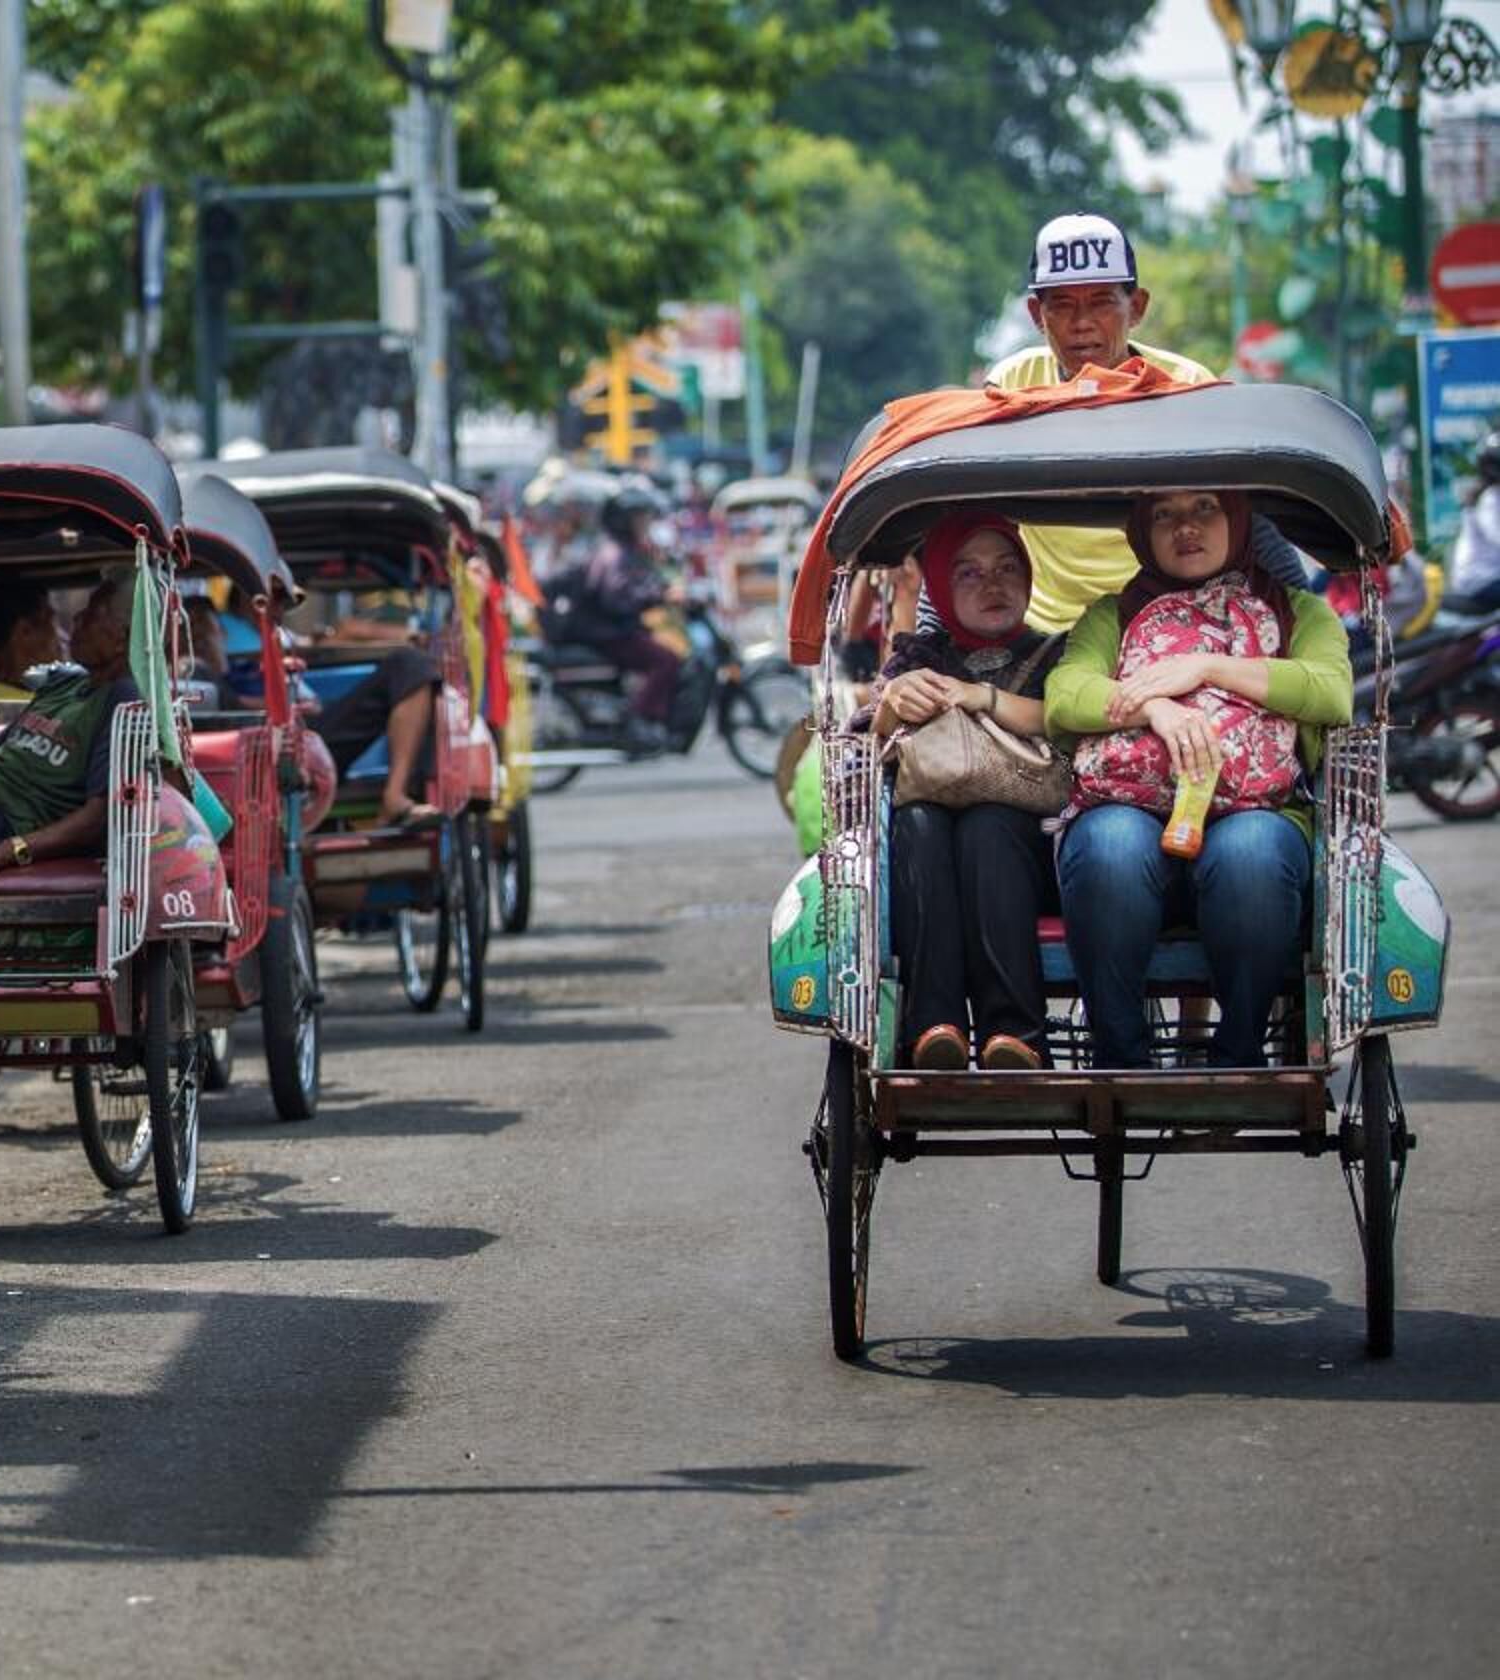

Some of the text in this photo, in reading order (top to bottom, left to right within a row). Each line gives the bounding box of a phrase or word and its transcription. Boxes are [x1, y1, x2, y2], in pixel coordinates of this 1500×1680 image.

[1048, 239, 1112, 273] BOY
[163, 889, 196, 917] 08
[794, 979, 812, 1005] 03
[1389, 973, 1411, 999] 03
